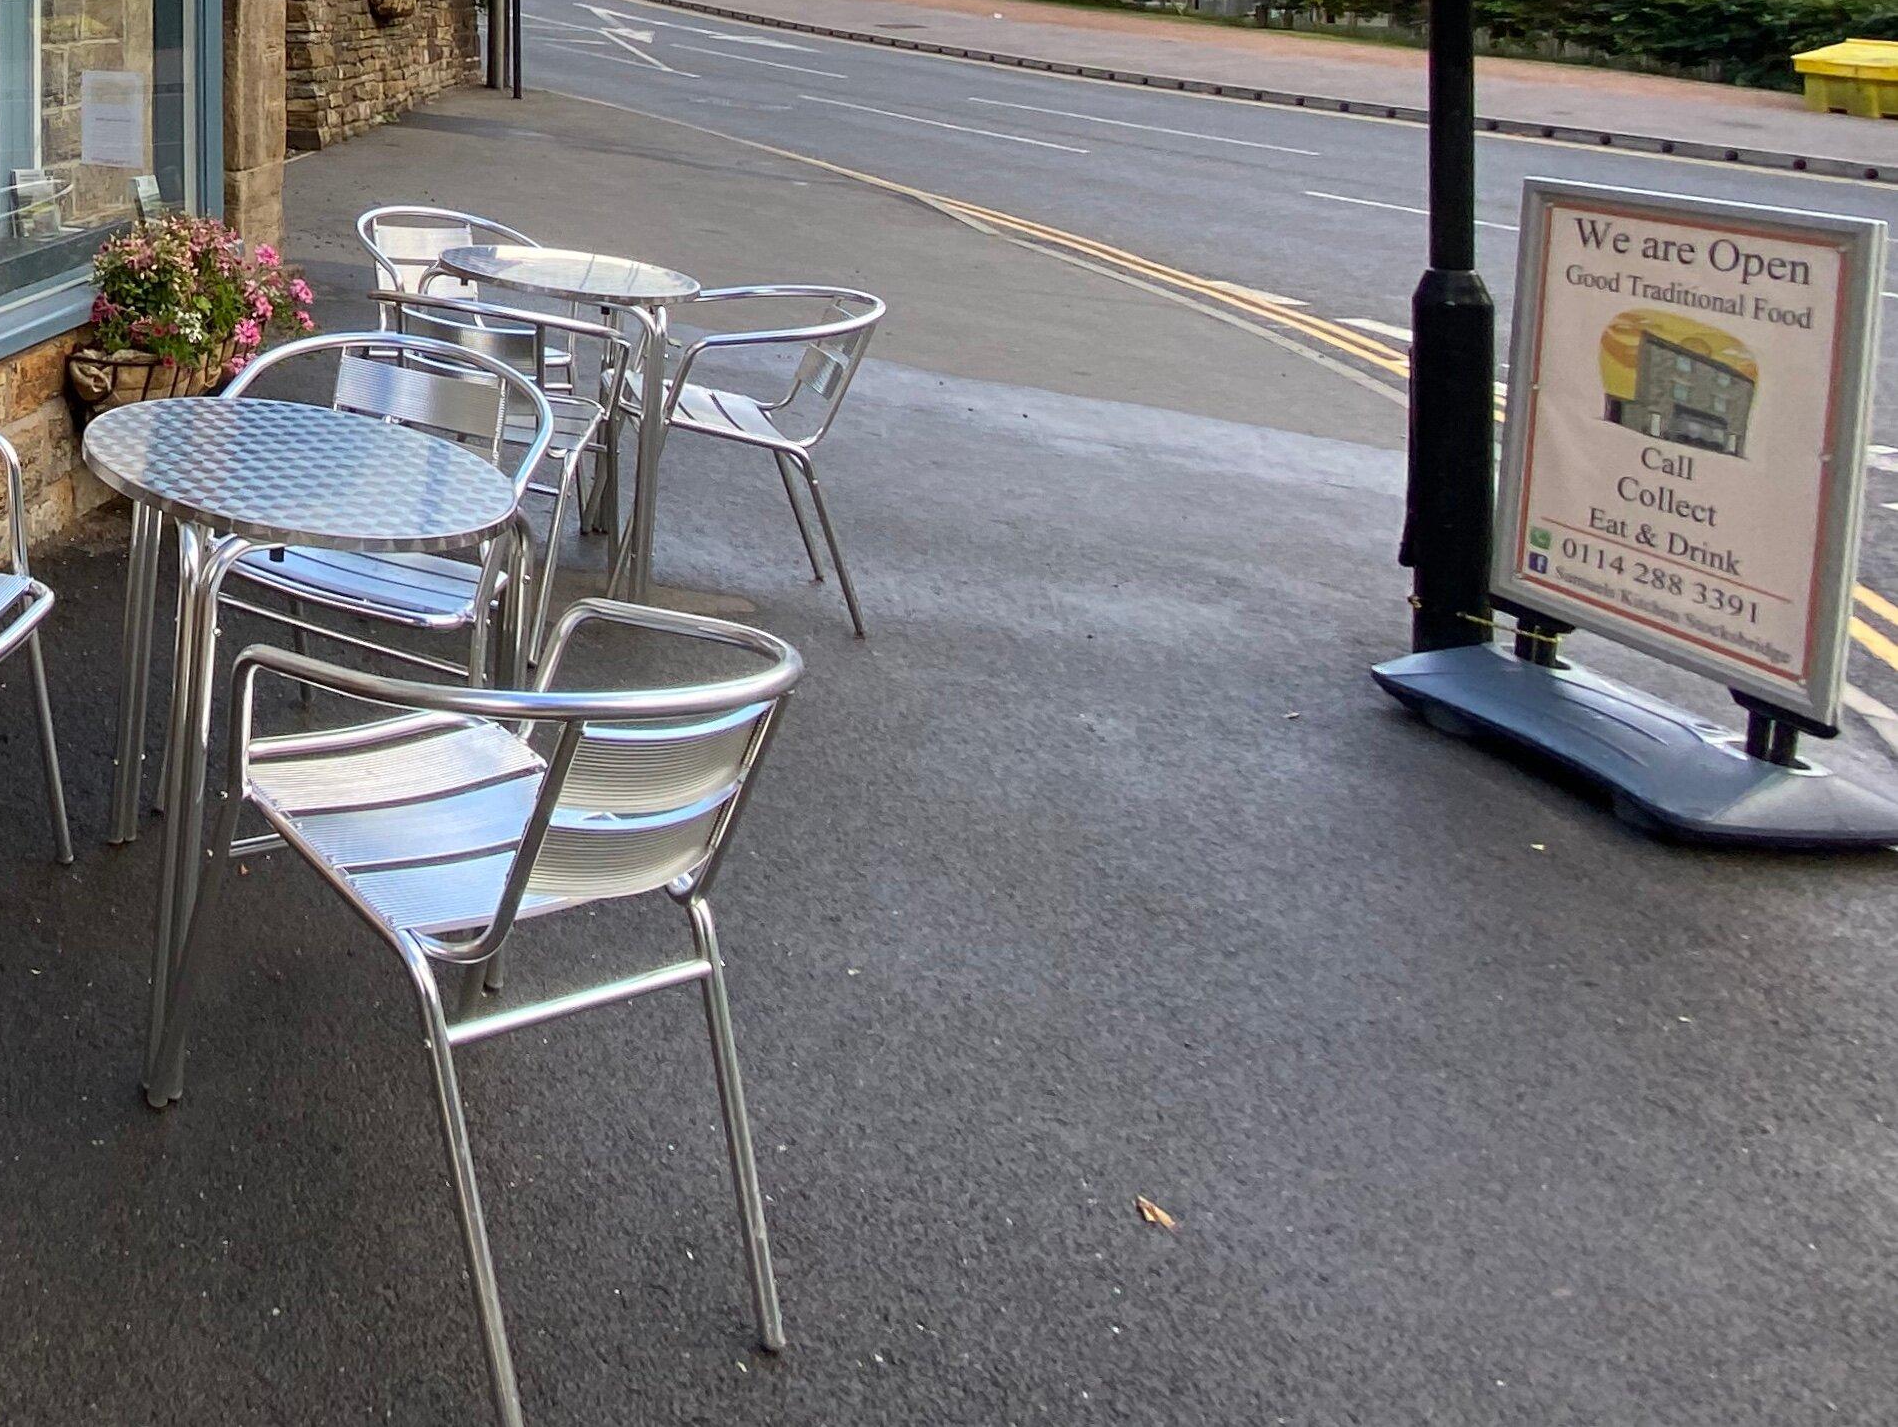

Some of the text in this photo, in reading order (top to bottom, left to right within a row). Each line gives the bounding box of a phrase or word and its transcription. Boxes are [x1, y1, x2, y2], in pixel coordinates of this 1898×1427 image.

[1574, 217, 1811, 286] We are Open
[1566, 264, 1815, 330] Good Traditional Food
[1641, 446, 1694, 481] Call
[1617, 476, 1718, 527] Collect
[1588, 506, 1741, 577] Eat & Drink
[1562, 538, 1758, 624] 0114 288 3391
